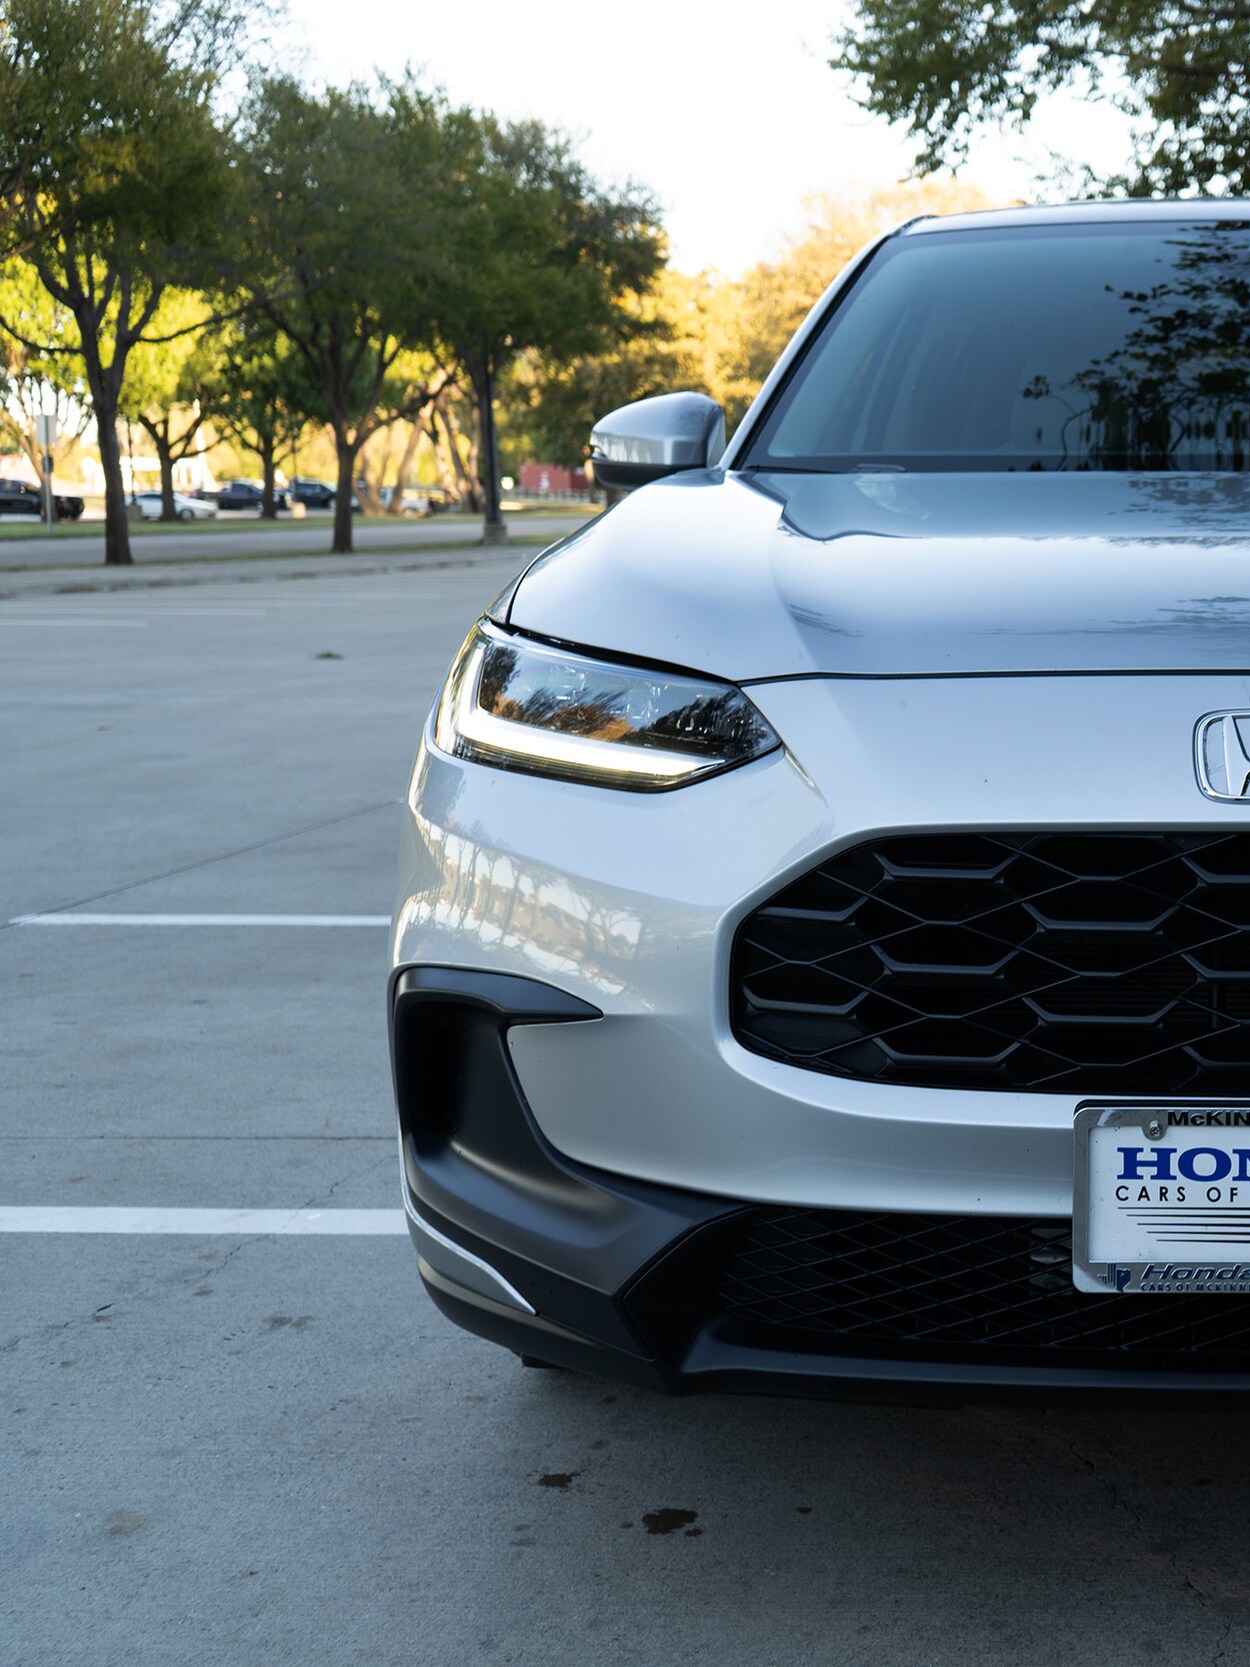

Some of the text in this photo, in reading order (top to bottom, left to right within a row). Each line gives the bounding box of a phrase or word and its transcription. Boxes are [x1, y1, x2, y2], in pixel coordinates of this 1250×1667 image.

[1115, 1185, 1186, 1202] CARS
[1206, 1187, 1238, 1202] OF
[1140, 1282, 1172, 1292] CARS
[1175, 1282, 1192, 1292] OF
